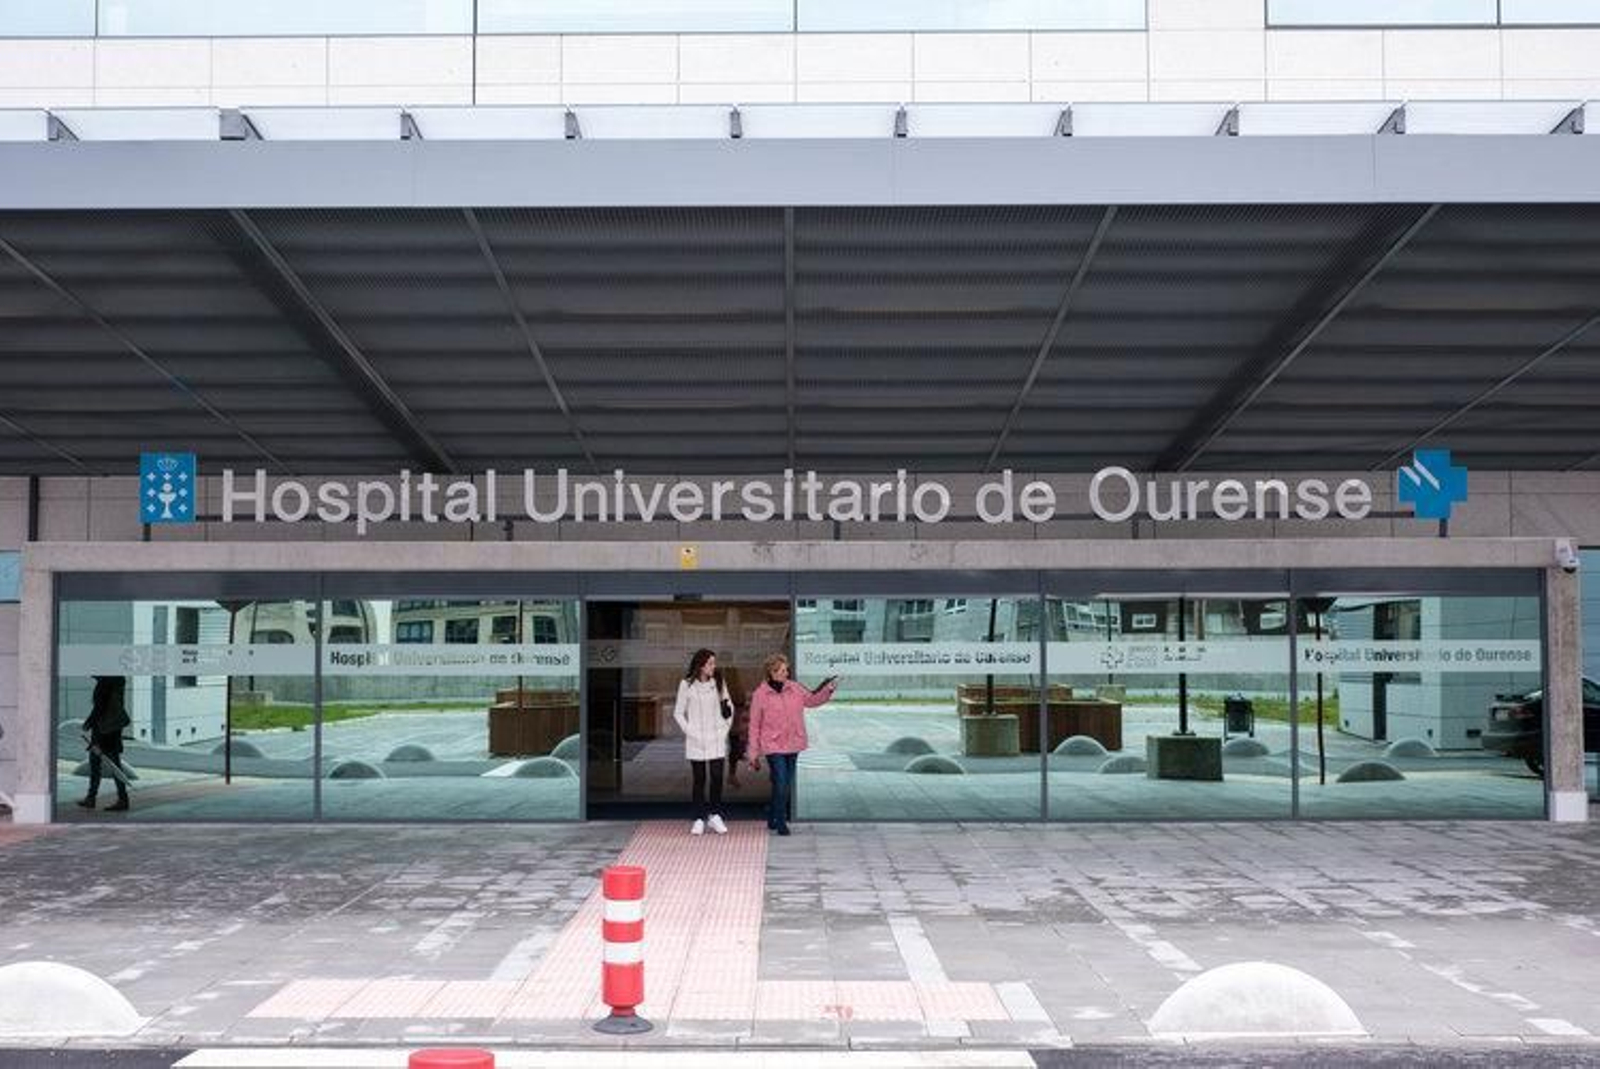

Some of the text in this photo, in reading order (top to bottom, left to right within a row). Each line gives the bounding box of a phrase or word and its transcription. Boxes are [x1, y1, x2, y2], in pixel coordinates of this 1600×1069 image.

[222, 466, 1373, 535] Hospital Universitario de Ourense
[1363, 648, 1451, 661] Universiio
[1475, 647, 1532, 661] Ourense
